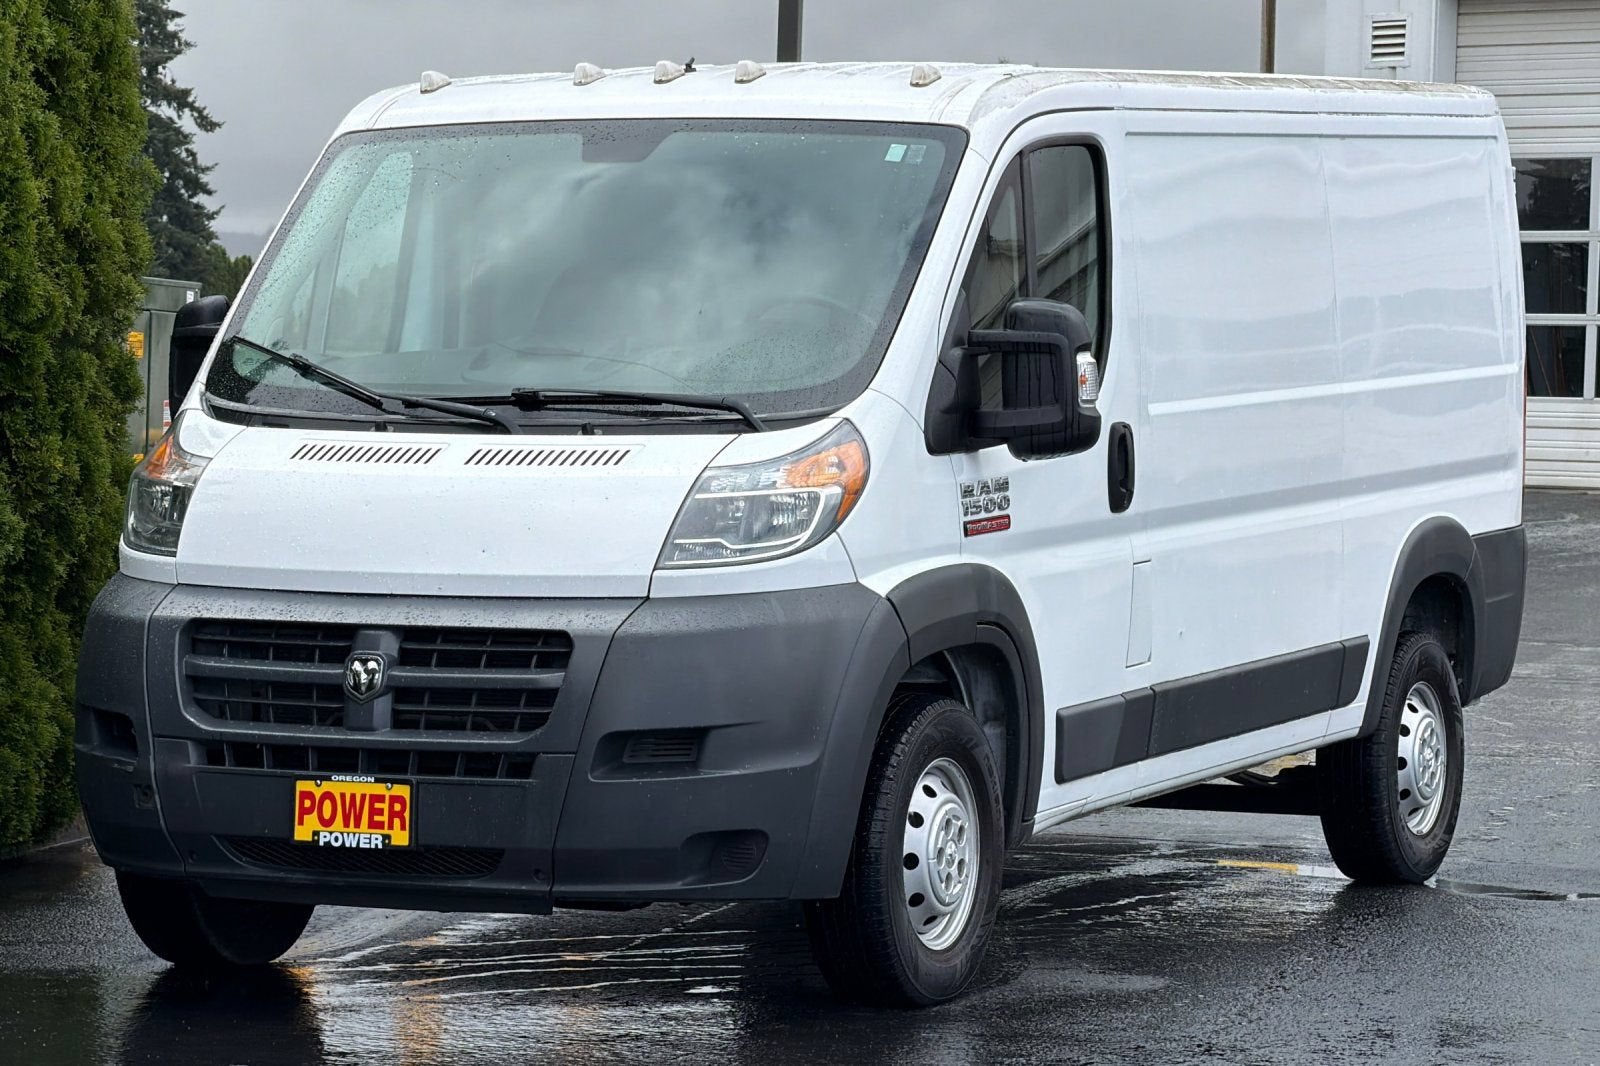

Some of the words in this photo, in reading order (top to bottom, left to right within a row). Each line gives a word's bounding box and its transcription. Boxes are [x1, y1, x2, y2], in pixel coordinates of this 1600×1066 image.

[960, 476, 1009, 499] RAM
[961, 494, 1010, 517] 1500
[331, 775, 375, 783] OREGON
[297, 790, 407, 831] POWER
[319, 831, 383, 849] POWER
